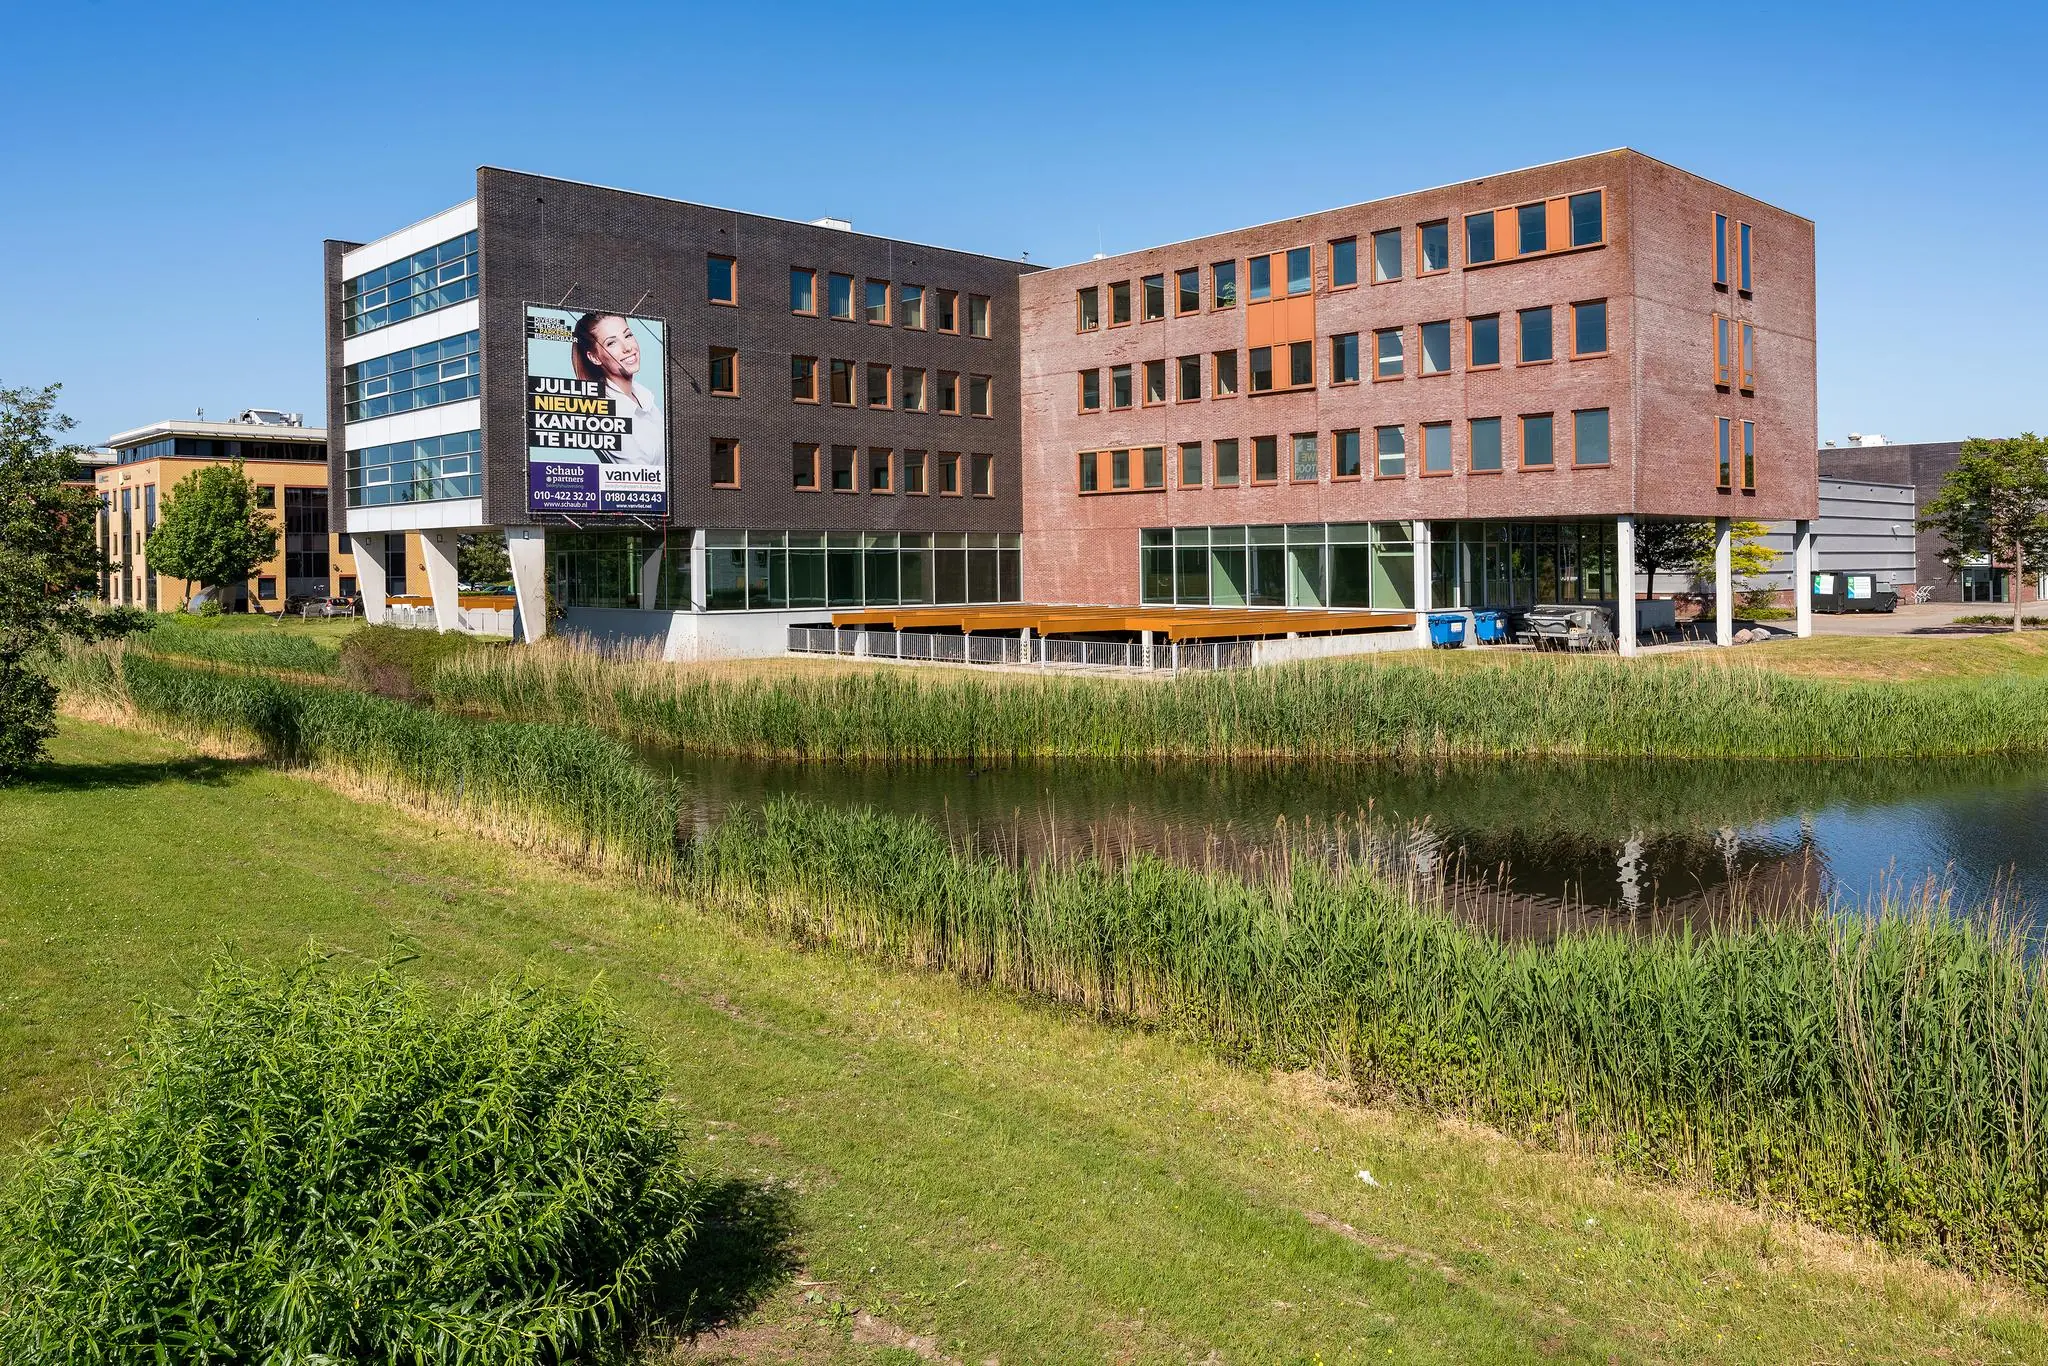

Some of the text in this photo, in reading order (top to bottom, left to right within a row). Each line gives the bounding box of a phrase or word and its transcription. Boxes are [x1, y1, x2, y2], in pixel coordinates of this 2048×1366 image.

[535, 378, 599, 396] JULLIE
[535, 396, 608, 414] NIEUWE
[535, 414, 626, 433] KANTOOR
[535, 431, 616, 450] TE HUUR
[545, 465, 585, 476] Schaub
[534, 490, 596, 501] 010-422 32 20
[605, 492, 662, 503] 0180 43 43 43
